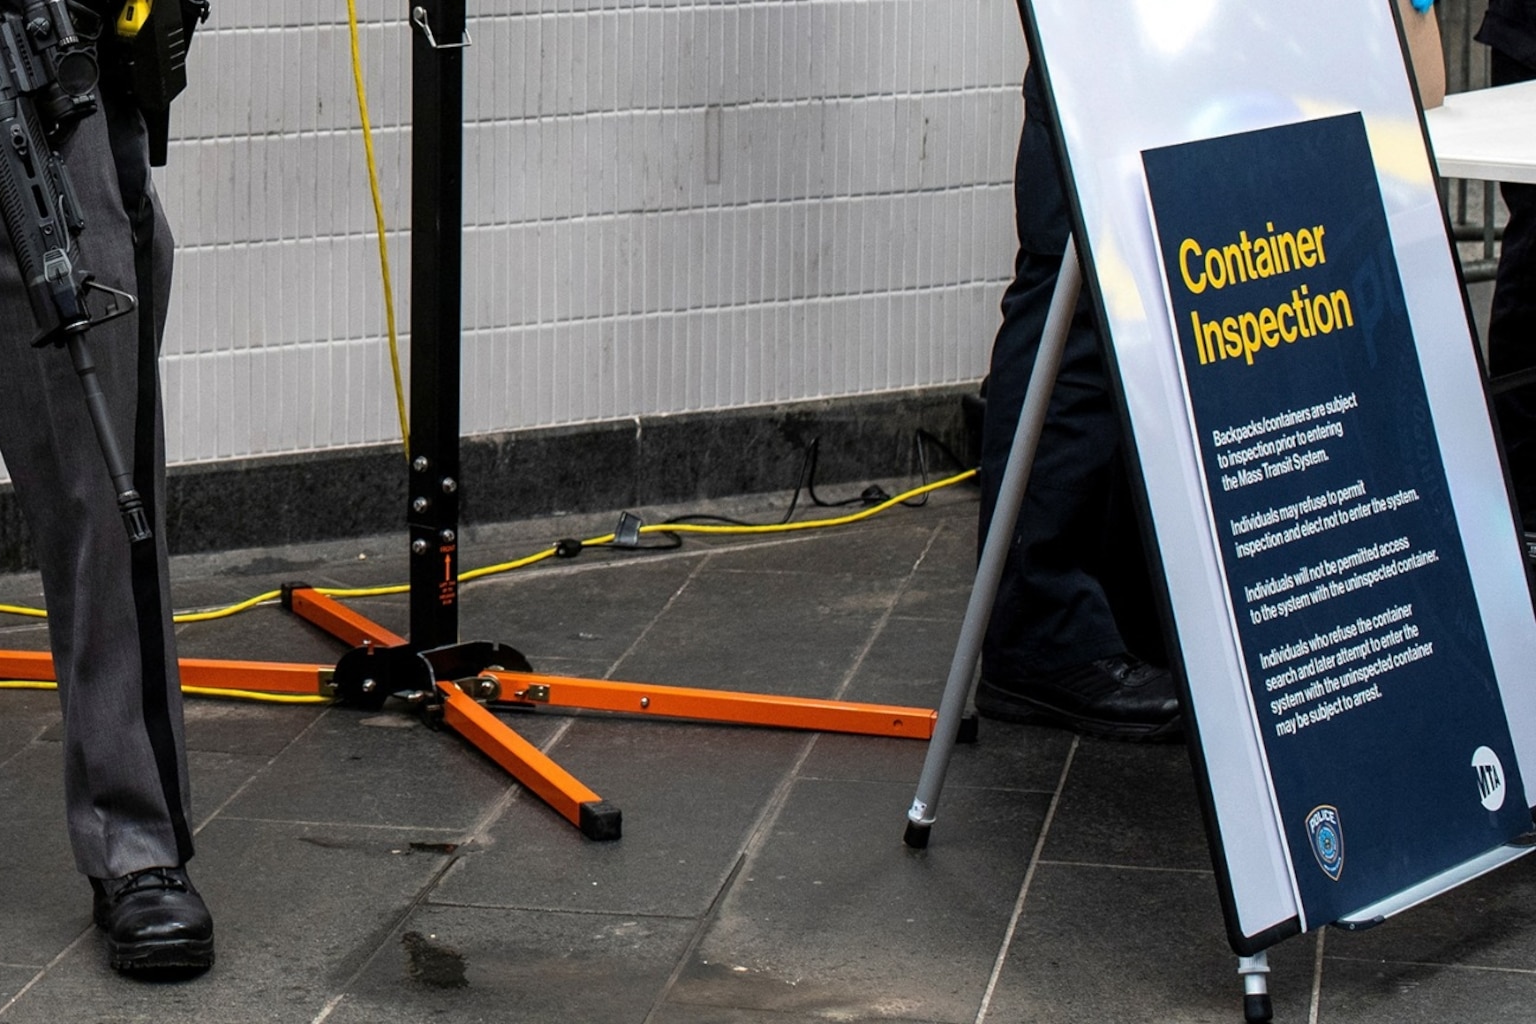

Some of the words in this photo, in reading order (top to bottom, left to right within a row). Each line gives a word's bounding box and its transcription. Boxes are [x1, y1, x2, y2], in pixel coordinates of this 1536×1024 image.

[1178, 221, 1327, 295] Container
[1190, 284, 1354, 367] Inspection
[1212, 408, 1311, 446] Backpacks/containers
[1310, 404, 1325, 418] are
[1325, 392, 1357, 414] subject
[1217, 453, 1228, 468] to
[1227, 440, 1275, 465] inspection
[1274, 434, 1296, 455] prior
[1295, 430, 1306, 445] to
[1306, 421, 1343, 442] entering
[1221, 474, 1238, 491] the
[1237, 468, 1263, 486] Mass
[1261, 456, 1293, 478] Transit
[1292, 449, 1329, 470] System.
[1230, 507, 1279, 535] Individuals
[1278, 503, 1298, 520] may
[1298, 494, 1327, 514] refuse
[1326, 490, 1337, 504] to
[1336, 479, 1366, 505] permit
[1234, 531, 1284, 557] inspection
[1283, 522, 1301, 542] and
[1300, 516, 1324, 536] elect
[1322, 511, 1339, 529] not
[1337, 509, 1350, 524] to
[1348, 503, 1371, 521] enter
[1370, 497, 1386, 513] the
[1386, 488, 1419, 510] system.
[1244, 573, 1294, 602] Individuals
[1293, 566, 1310, 585] will
[1308, 562, 1325, 580] not
[1323, 559, 1337, 575] be
[1336, 542, 1379, 574] permitted
[1378, 536, 1409, 556] access
[1249, 609, 1261, 624] to
[1260, 604, 1277, 620] the
[1276, 593, 1310, 616] system
[1309, 584, 1330, 603] with
[1328, 580, 1345, 596] the
[1344, 559, 1398, 591] uninspected
[1396, 549, 1439, 573] container.
[1259, 639, 1309, 669] Individuals
[1308, 633, 1329, 651] who
[1328, 623, 1357, 644] refuse
[1356, 617, 1372, 633] the
[1372, 603, 1412, 628] container
[1265, 666, 1298, 691] search
[1297, 658, 1315, 679] and
[1313, 655, 1335, 673] later
[1335, 639, 1371, 665] attempt
[1369, 637, 1382, 652] to
[1380, 629, 1403, 648] enter
[1402, 623, 1418, 639] the
[1270, 690, 1305, 715] system
[1303, 680, 1325, 700] with
[1323, 676, 1340, 693] the
[1339, 653, 1393, 687] uninspected
[1393, 641, 1432, 667] container
[1275, 717, 1296, 736] may
[1295, 712, 1309, 728] be
[1308, 697, 1343, 723] subject
[1342, 695, 1353, 710] to
[1352, 683, 1382, 706] arrest.
[1474, 764, 1501, 803] MTA
[1309, 809, 1337, 834] POLICE
